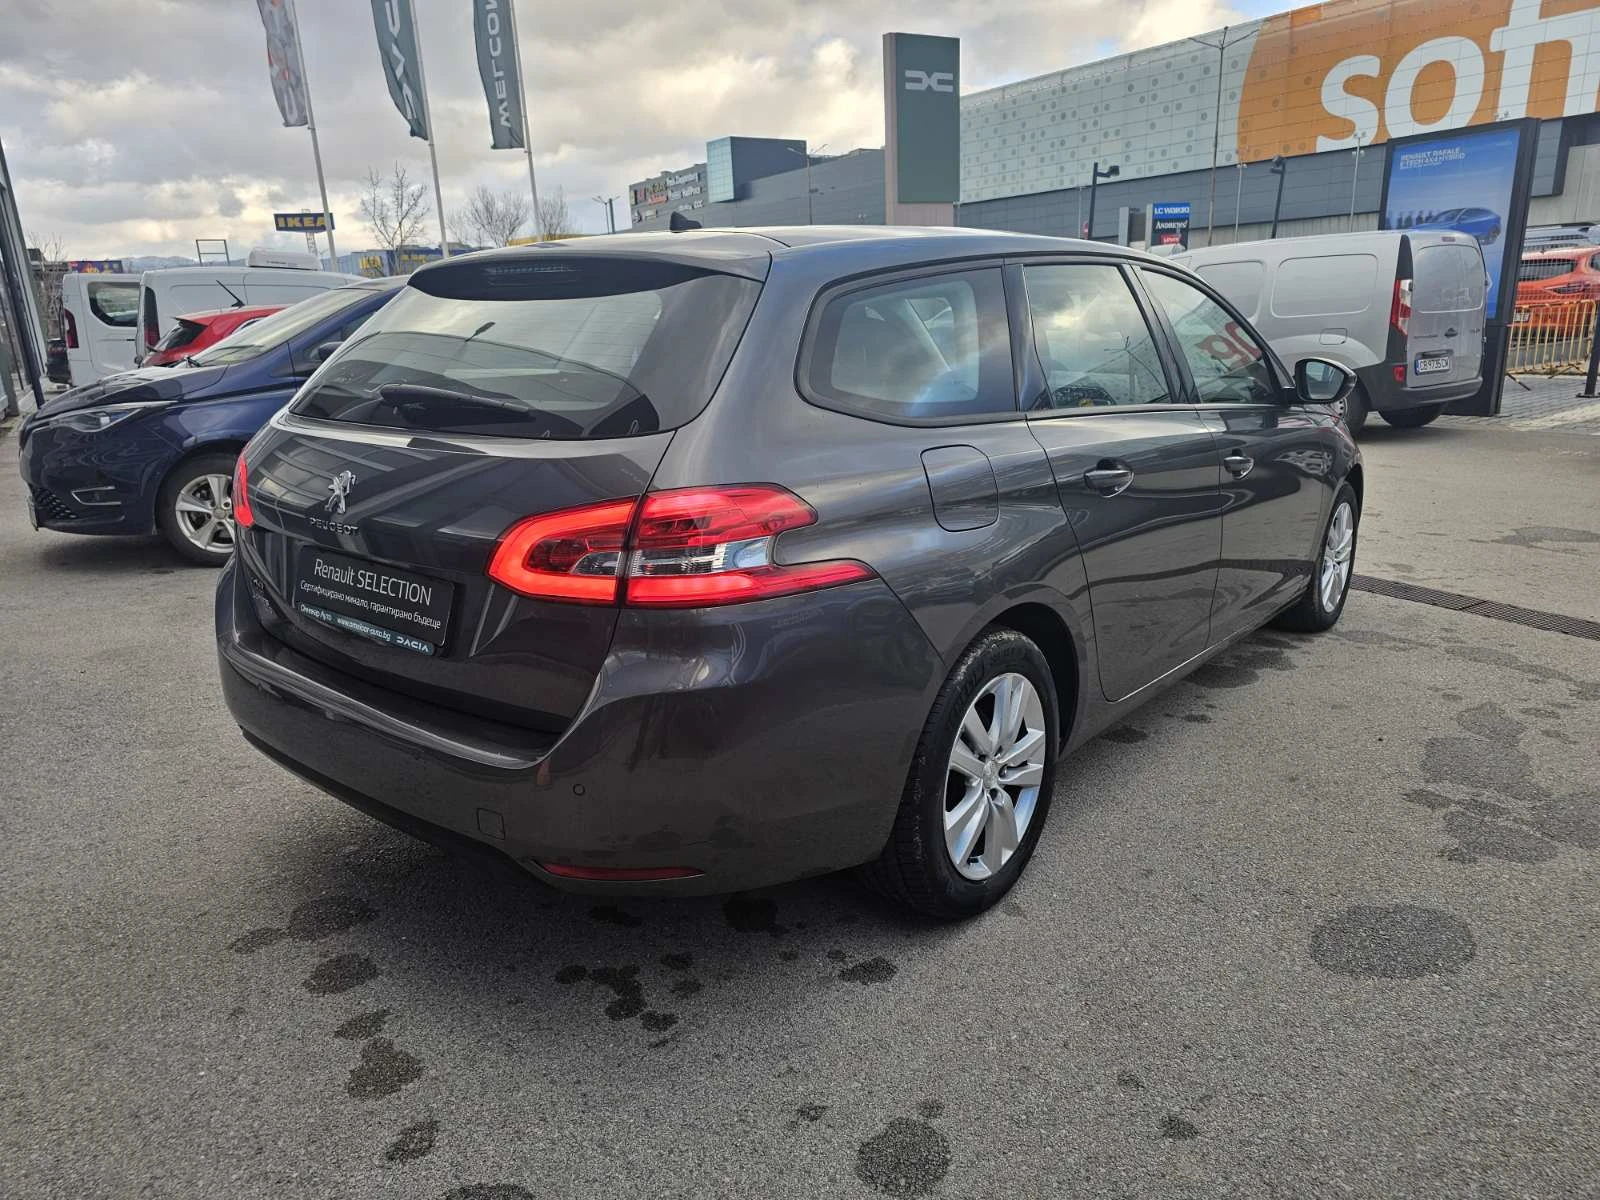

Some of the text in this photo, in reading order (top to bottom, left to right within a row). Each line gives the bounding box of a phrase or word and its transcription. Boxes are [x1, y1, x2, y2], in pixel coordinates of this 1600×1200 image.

[277, 216, 329, 227] IKEA
[309, 517, 359, 534] PEUGEOT
[314, 558, 432, 606] Renault SELECTION
[300, 579, 344, 601] Сертифицирано
[370, 601, 413, 621] гарантирано
[413, 611, 441, 629] бъдеще
[396, 635, 429, 652] DACIA
